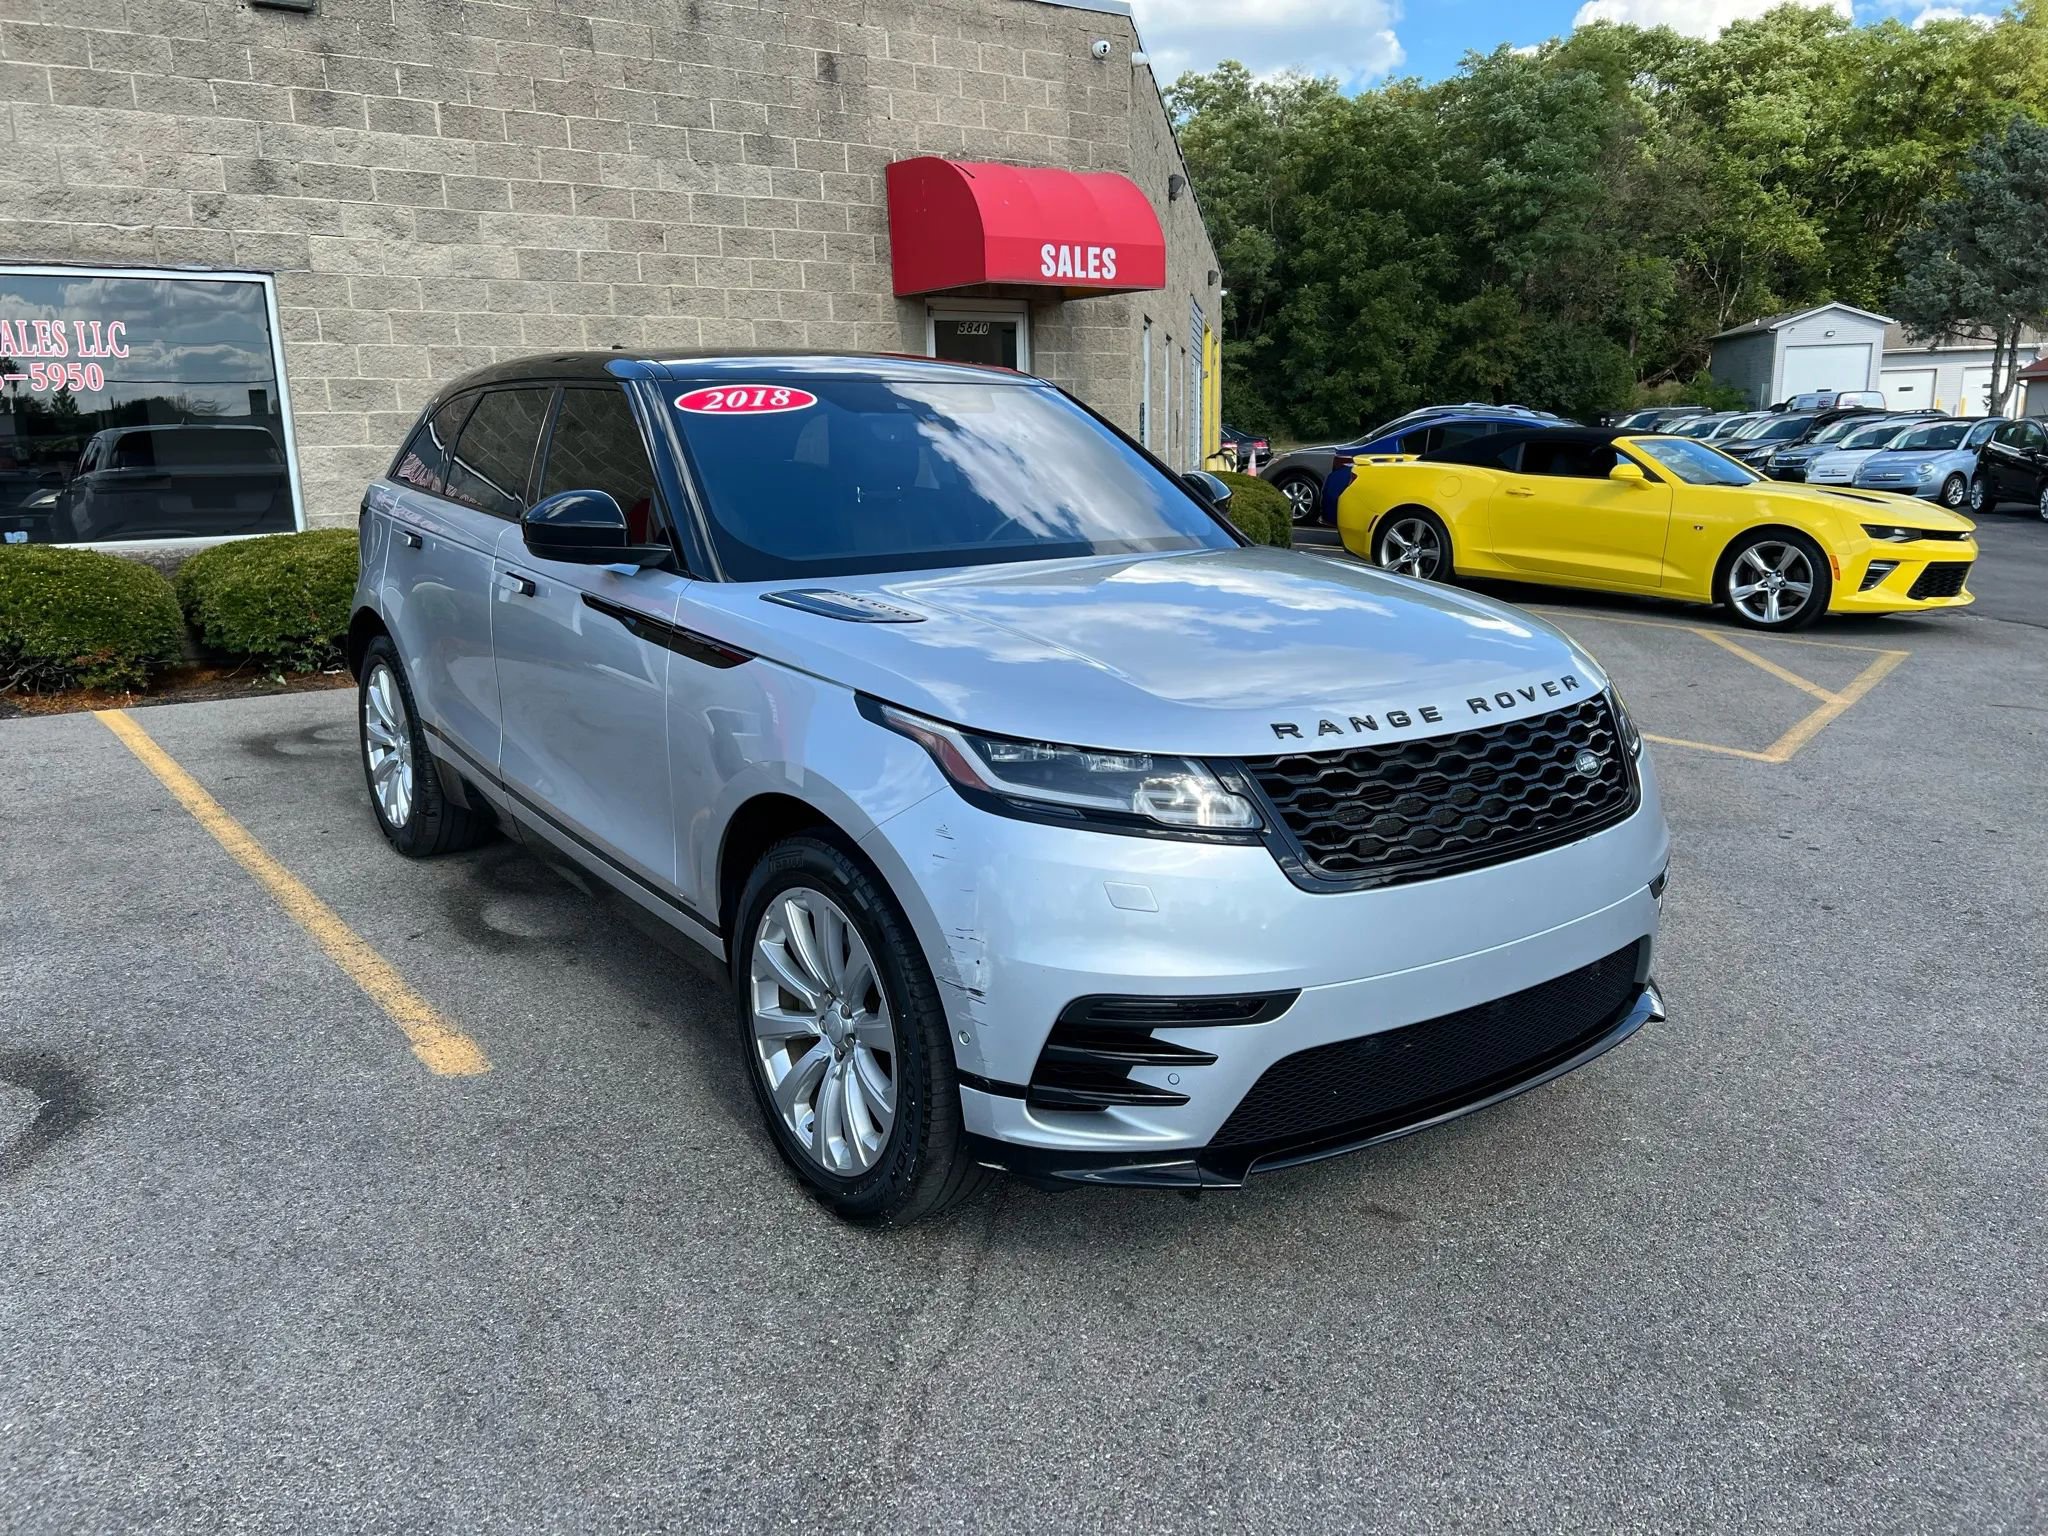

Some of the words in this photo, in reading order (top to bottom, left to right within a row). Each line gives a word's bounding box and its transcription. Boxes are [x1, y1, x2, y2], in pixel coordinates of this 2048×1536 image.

[1041, 244, 1116, 279] SALES
[74, 321, 129, 358] LLC
[959, 322, 988, 334] 5840
[0, 363, 104, 391] -5950
[702, 389, 791, 410] 2018
[1270, 705, 1444, 740] RANGE
[1466, 674, 1580, 714] ROVER
